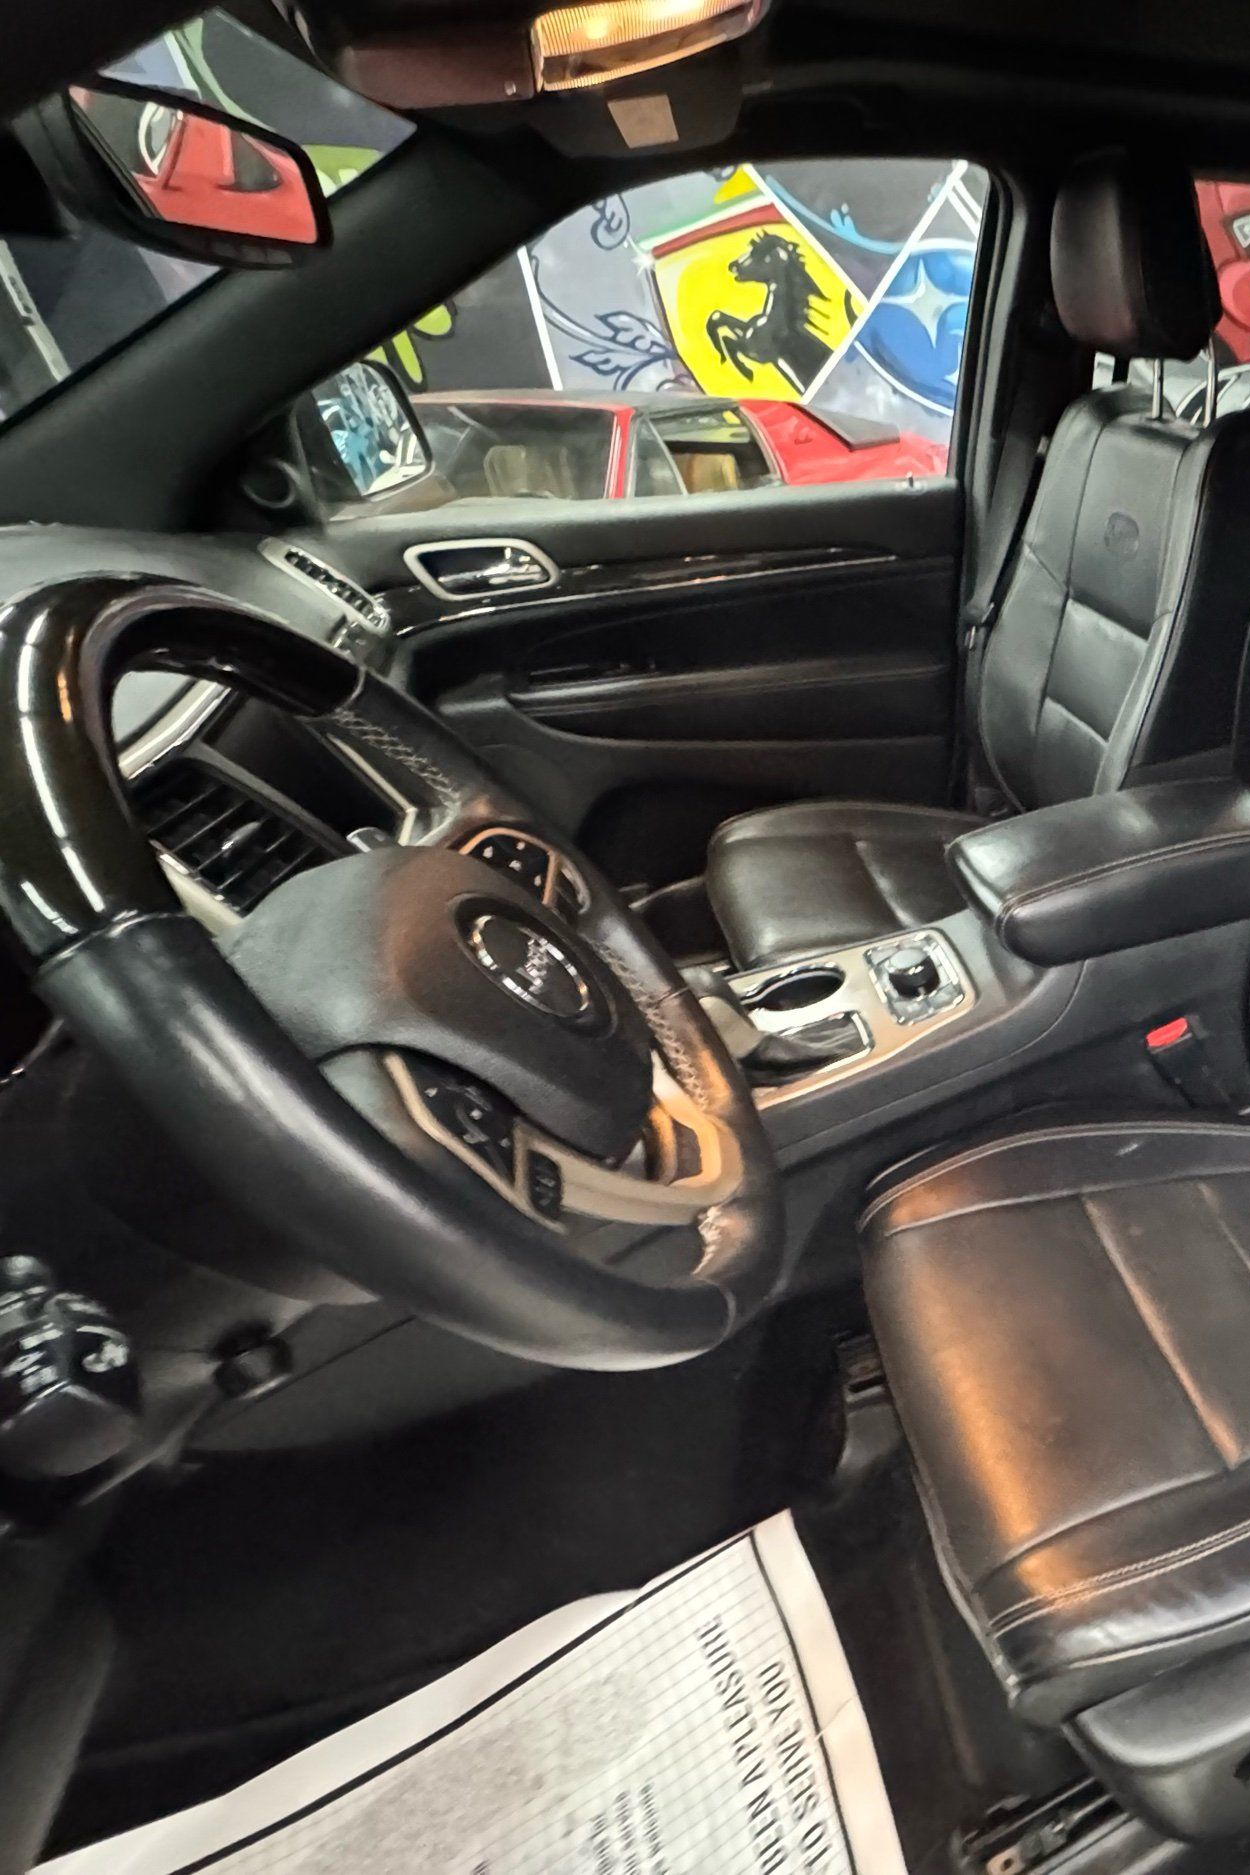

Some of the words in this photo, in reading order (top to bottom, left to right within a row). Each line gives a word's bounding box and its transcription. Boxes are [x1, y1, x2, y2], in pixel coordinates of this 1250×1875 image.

[694, 1615, 761, 1764] PLEASURE
[757, 1661, 796, 1729] YOU
[739, 1758, 768, 1789] A
[774, 1719, 819, 1821] SERVE
[745, 1785, 789, 1875] BEEN
[800, 1819, 832, 1874] TO
